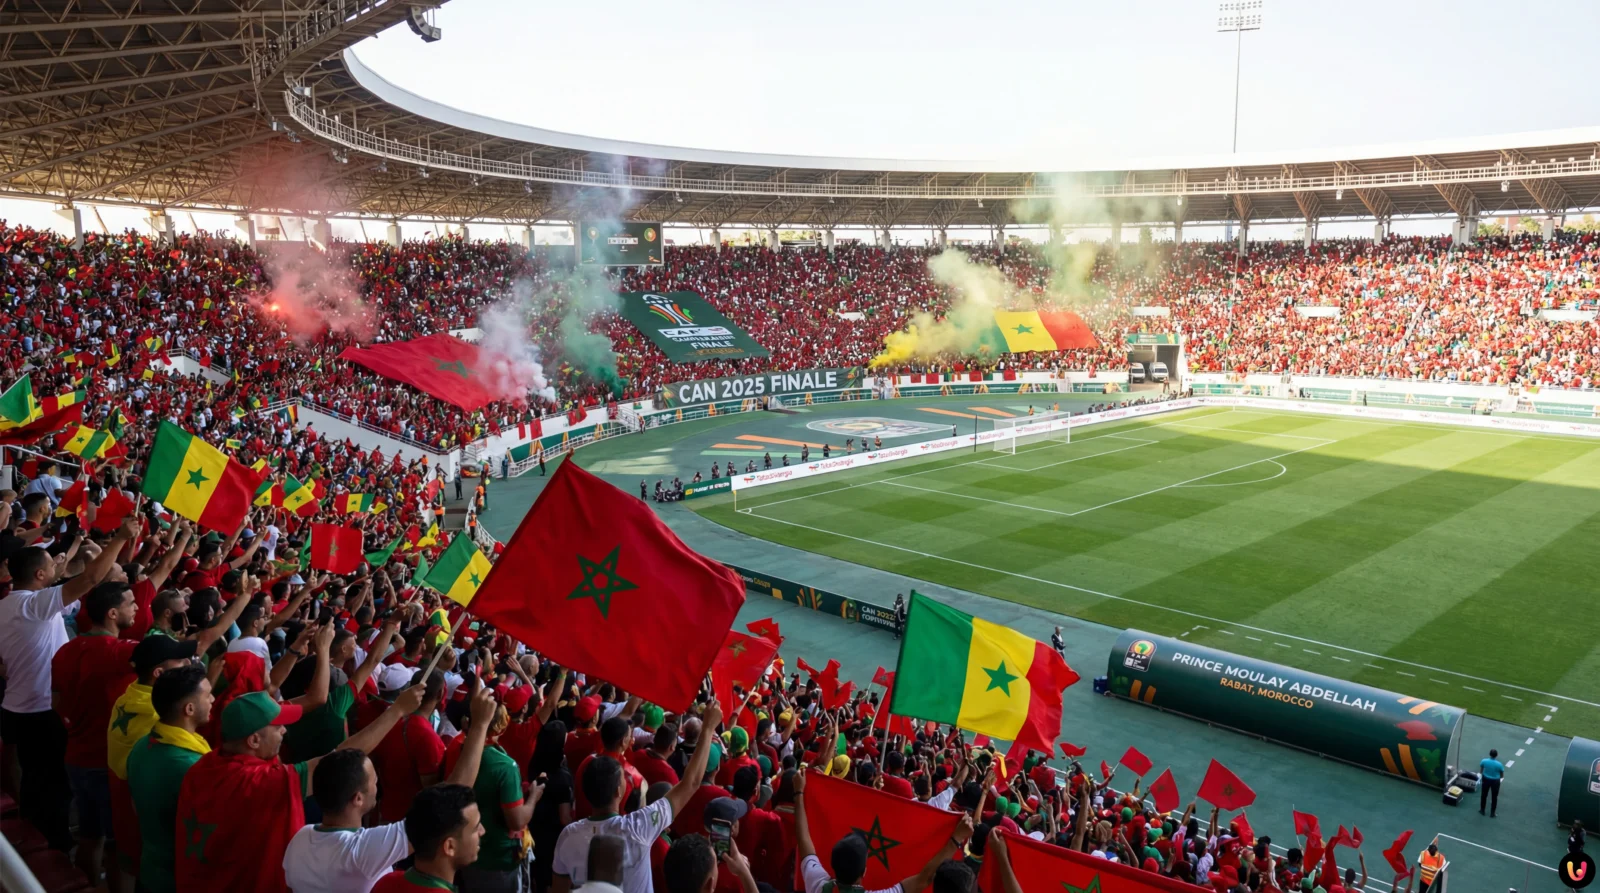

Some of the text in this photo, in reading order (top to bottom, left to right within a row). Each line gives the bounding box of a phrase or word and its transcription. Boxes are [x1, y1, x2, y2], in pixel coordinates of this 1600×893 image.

[690, 340, 734, 350] FINALE
[679, 371, 838, 404] CAN 2025 FINALE
[861, 606, 876, 615] CAN
[1172, 652, 1224, 673] PRINCE
[1224, 665, 1289, 689] MOULAY
[1289, 682, 1377, 712] ABDELLAH
[1219, 677, 1315, 709] RABAT, MOROCCO
